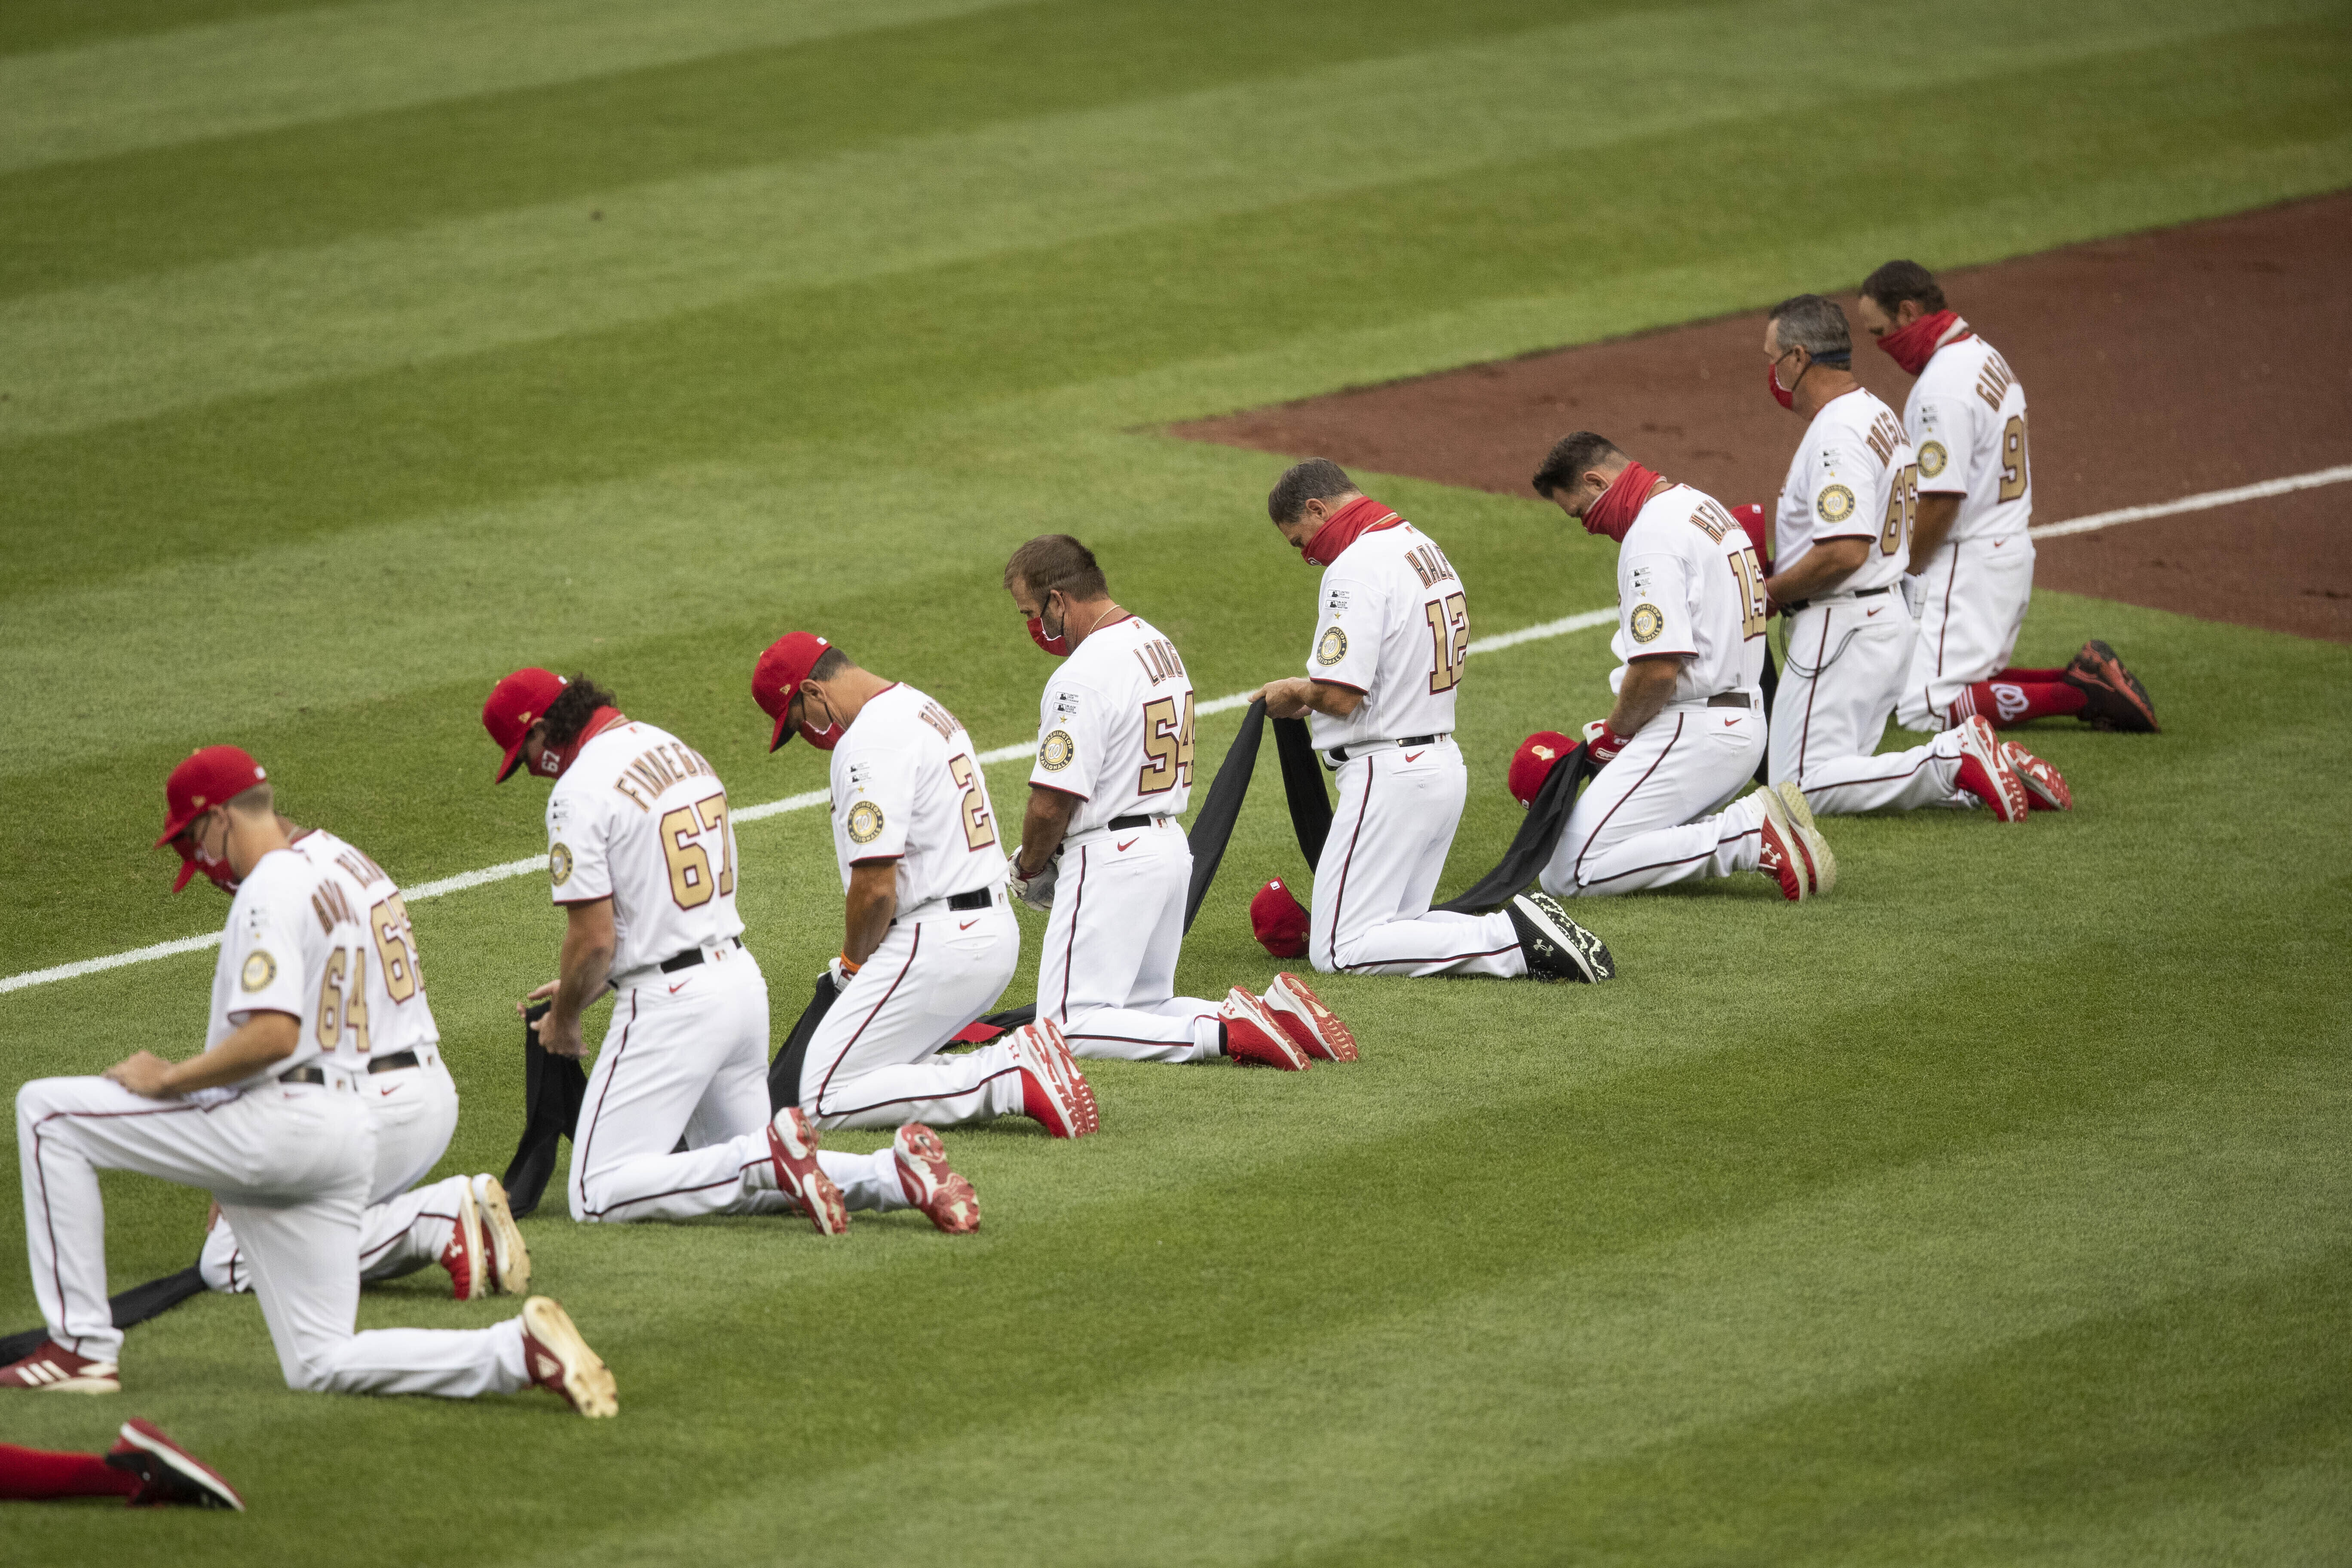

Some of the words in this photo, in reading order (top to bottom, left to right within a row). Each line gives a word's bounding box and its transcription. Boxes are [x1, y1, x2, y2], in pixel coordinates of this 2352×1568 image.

[1998, 408, 2030, 505] 9
[1405, 543, 1455, 589] HALE
[1727, 546, 1767, 643] 15
[1133, 640, 1183, 686] LONG
[1317, 652, 1342, 665] NATIONALS
[1321, 628, 1346, 643] WASHINGTON
[1425, 591, 1470, 695] 12
[541, 750, 560, 773] 67
[1040, 755, 1069, 770] NATIONALS
[1044, 731, 1072, 749] WASHINGTON
[1138, 690, 1194, 796] 54
[614, 741, 718, 813] FINNEGA
[949, 753, 995, 852] 2
[660, 792, 733, 911] 67
[315, 946, 370, 1053] 64
